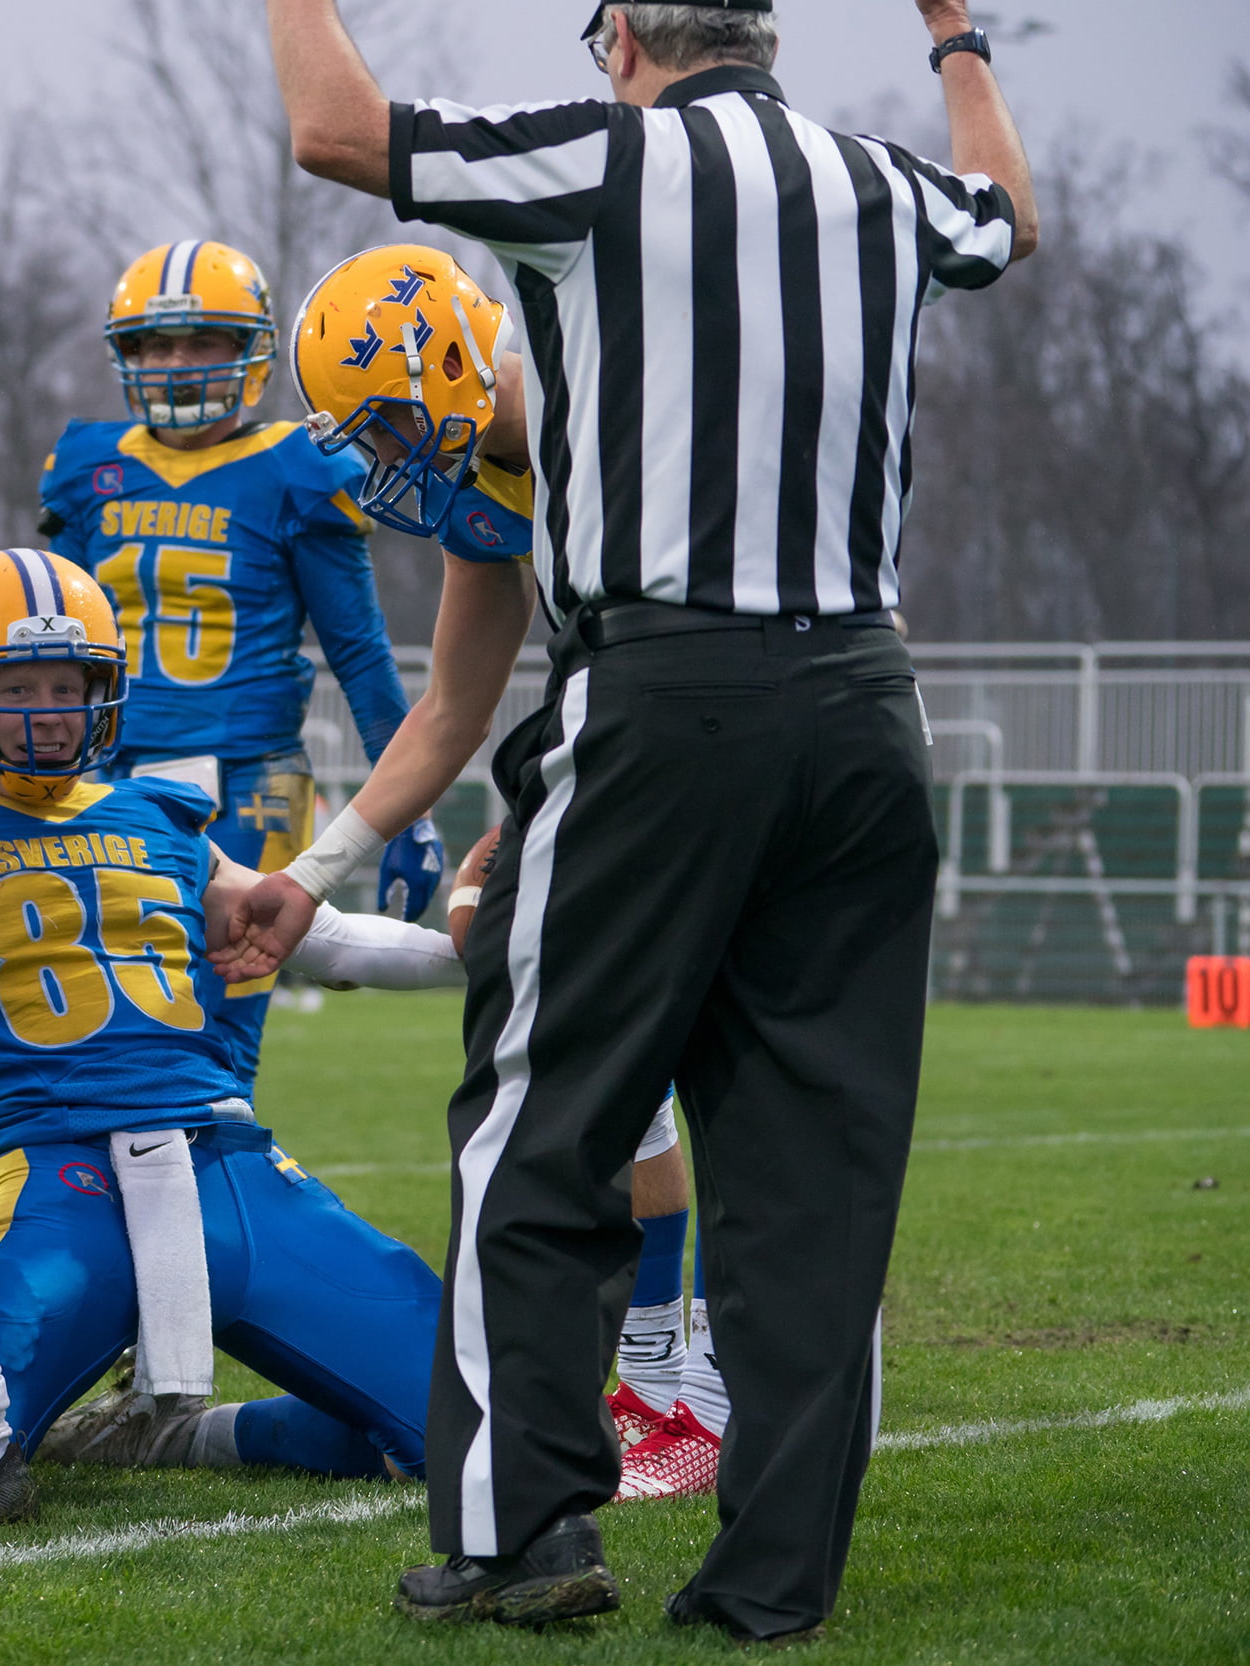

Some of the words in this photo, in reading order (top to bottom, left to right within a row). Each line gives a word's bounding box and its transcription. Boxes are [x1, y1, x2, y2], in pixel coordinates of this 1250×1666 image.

[101, 500, 231, 543] SVERIGE
[94, 542, 237, 686] 15
[1199, 968, 1239, 1020] 10
